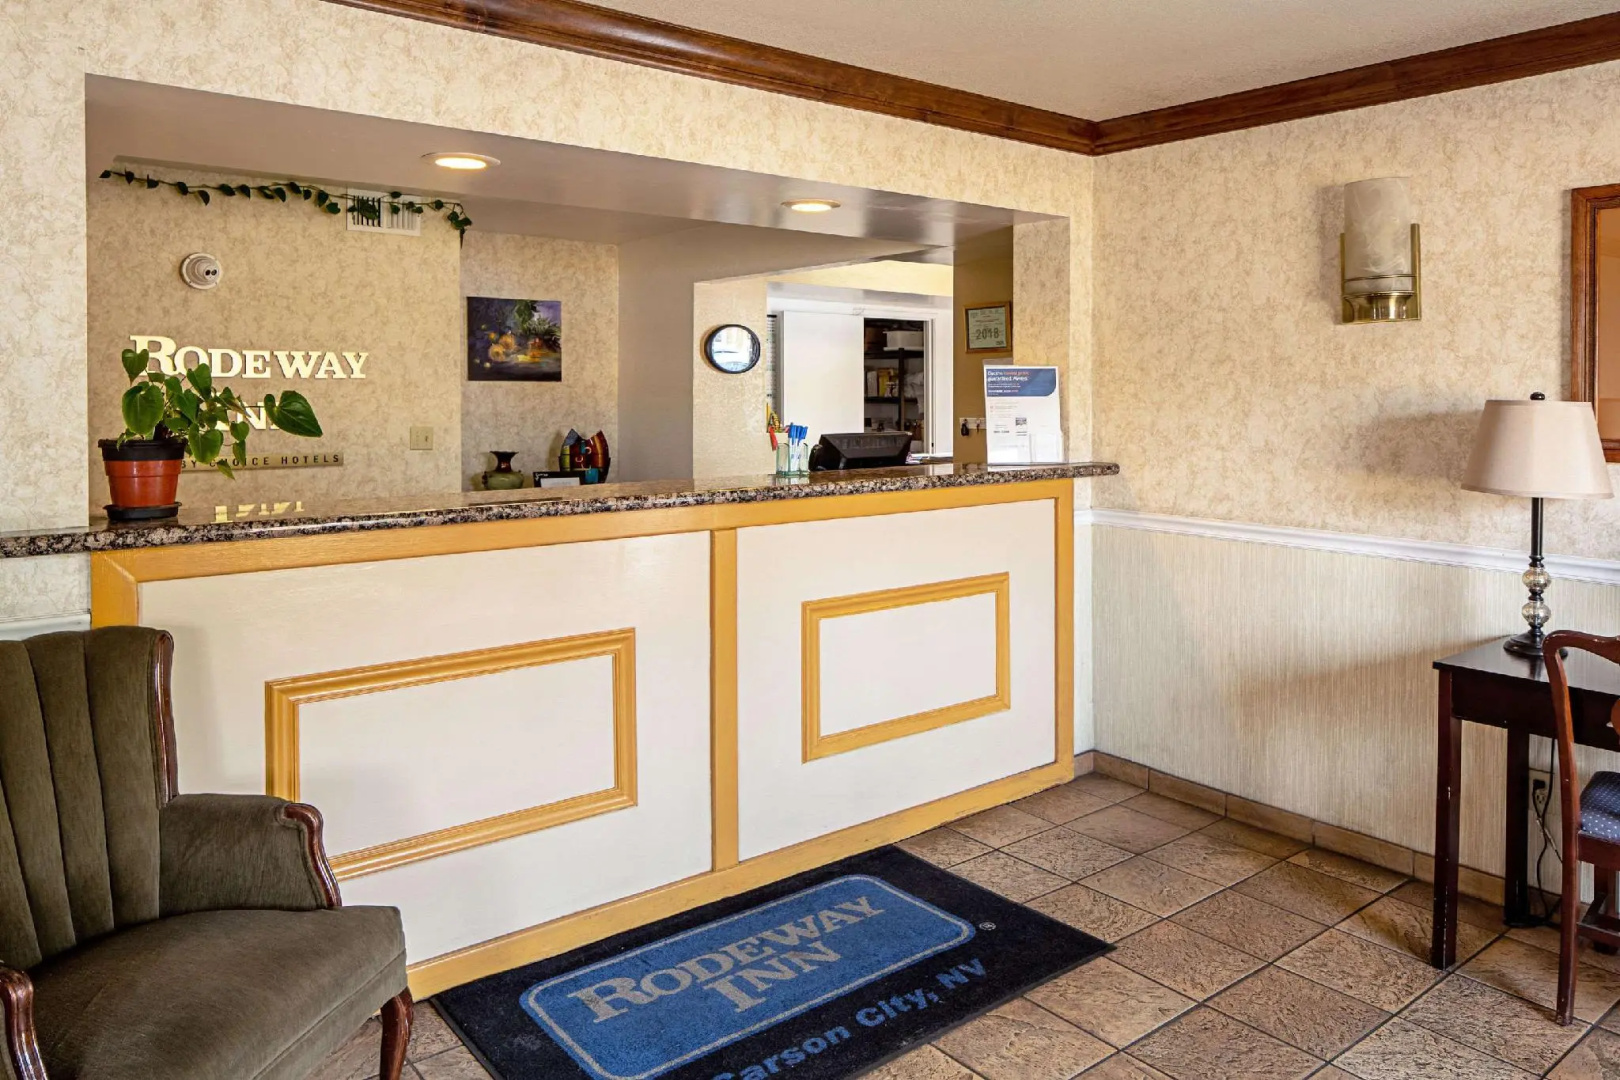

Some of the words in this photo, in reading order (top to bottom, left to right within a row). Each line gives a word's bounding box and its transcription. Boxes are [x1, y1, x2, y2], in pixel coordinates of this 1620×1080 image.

[129, 335, 369, 379] RODEWAY
[975, 327, 1000, 340] 2018
[209, 457, 270, 467] COICE
[281, 454, 340, 465] HOTELS
[567, 896, 886, 1024] RODEWAY
[703, 940, 842, 1014] INN
[854, 987, 940, 1027] City,
[935, 957, 987, 990] NV
